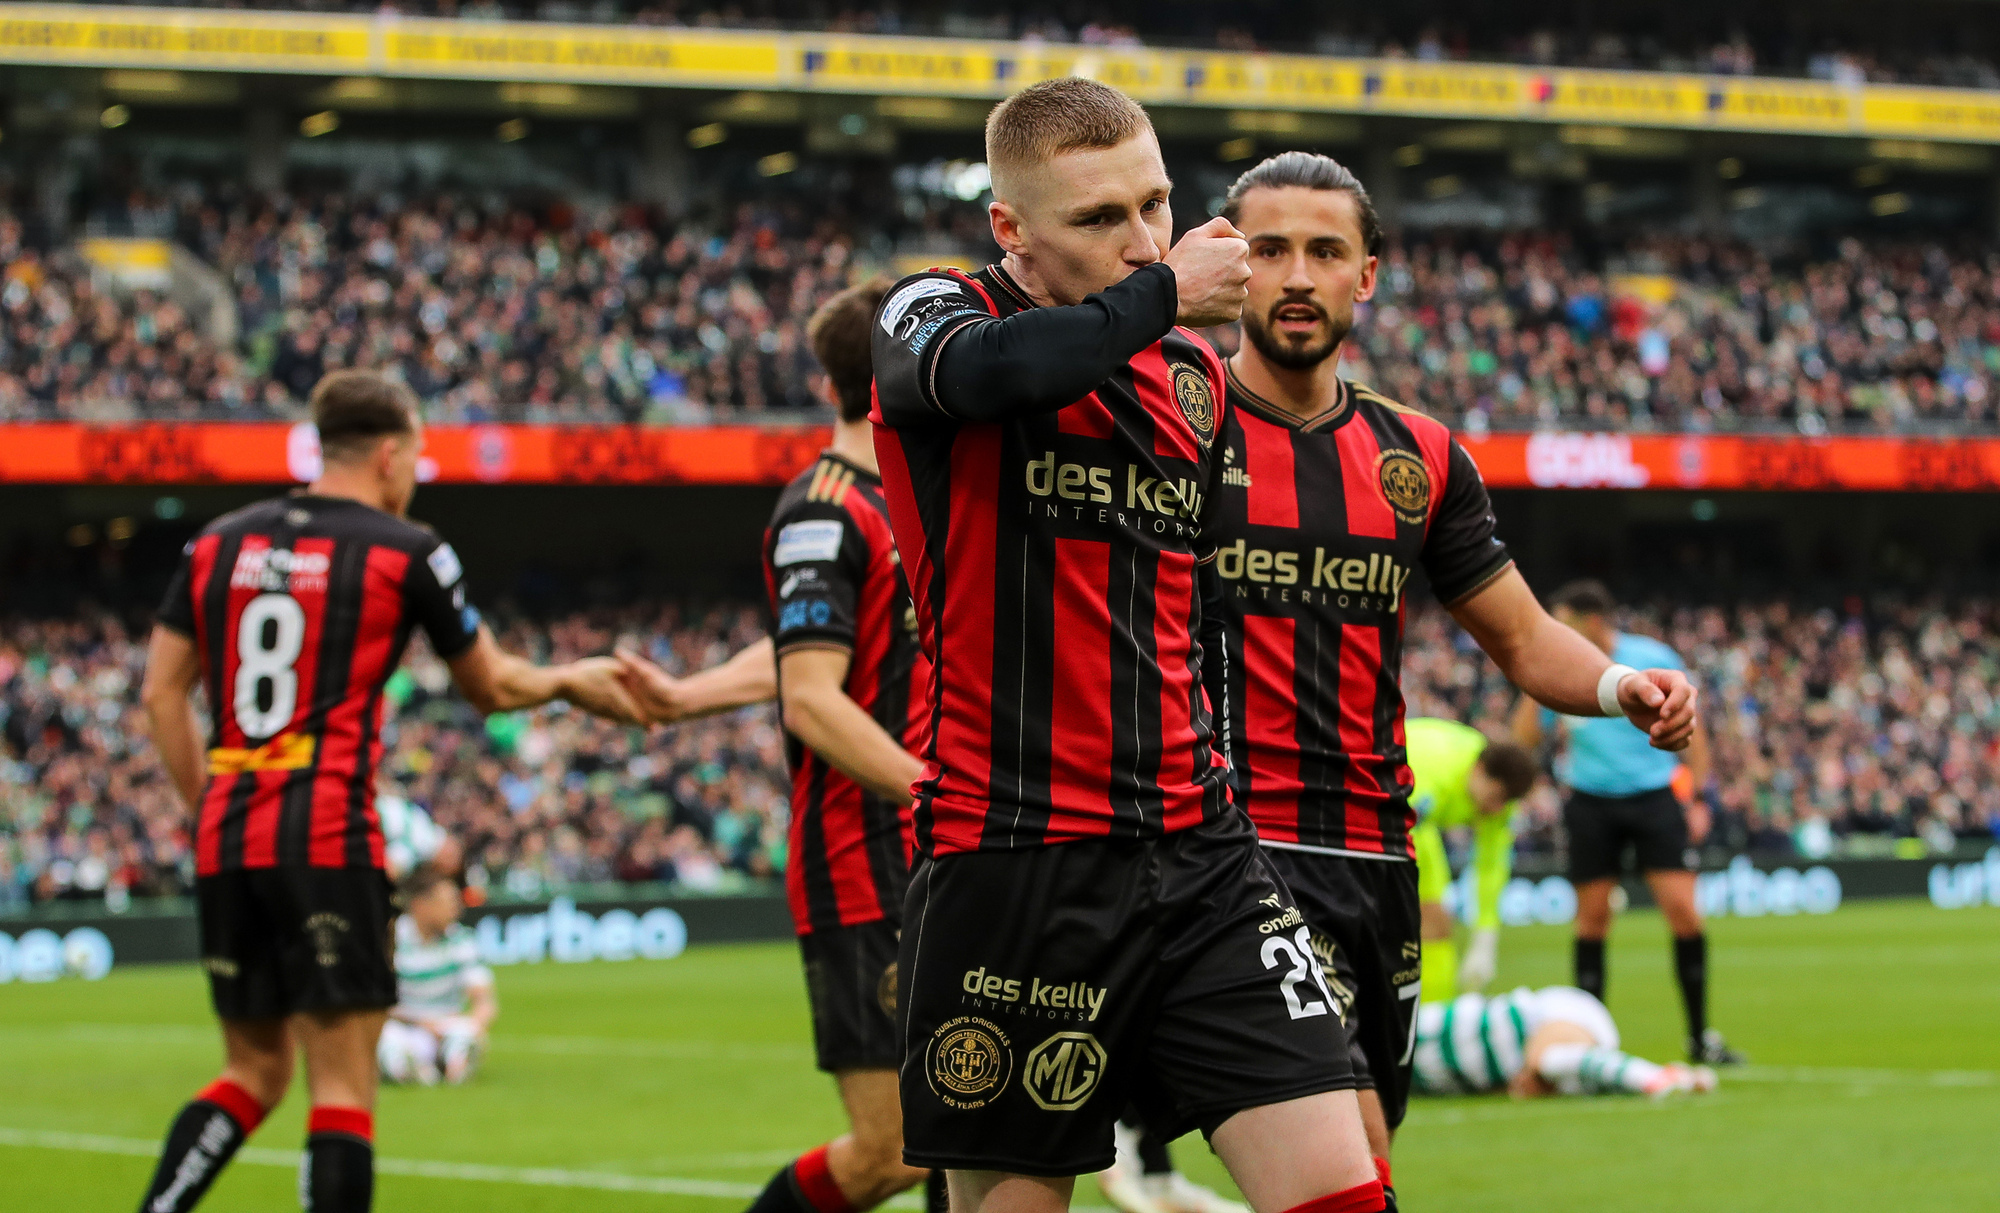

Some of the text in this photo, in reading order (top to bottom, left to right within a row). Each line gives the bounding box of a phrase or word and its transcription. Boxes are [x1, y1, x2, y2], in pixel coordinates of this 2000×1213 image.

[1026, 451, 1112, 503] des
[1028, 501, 1197, 538] INTERIORS
[1216, 539, 1411, 613] des kelly
[1236, 585, 1384, 612] NTERIORS
[233, 593, 305, 739] 8
[1694, 854, 1842, 918] rbeo
[476, 895, 688, 967] urbeo
[961, 995, 1084, 1021] INTERIORS
[963, 966, 1108, 1022] des kelly
[934, 1015, 1011, 1047] DUBLIN'S ORIGINALS
[1034, 1041, 1098, 1101] MG
[942, 1095, 985, 1111] 135 YEARS
